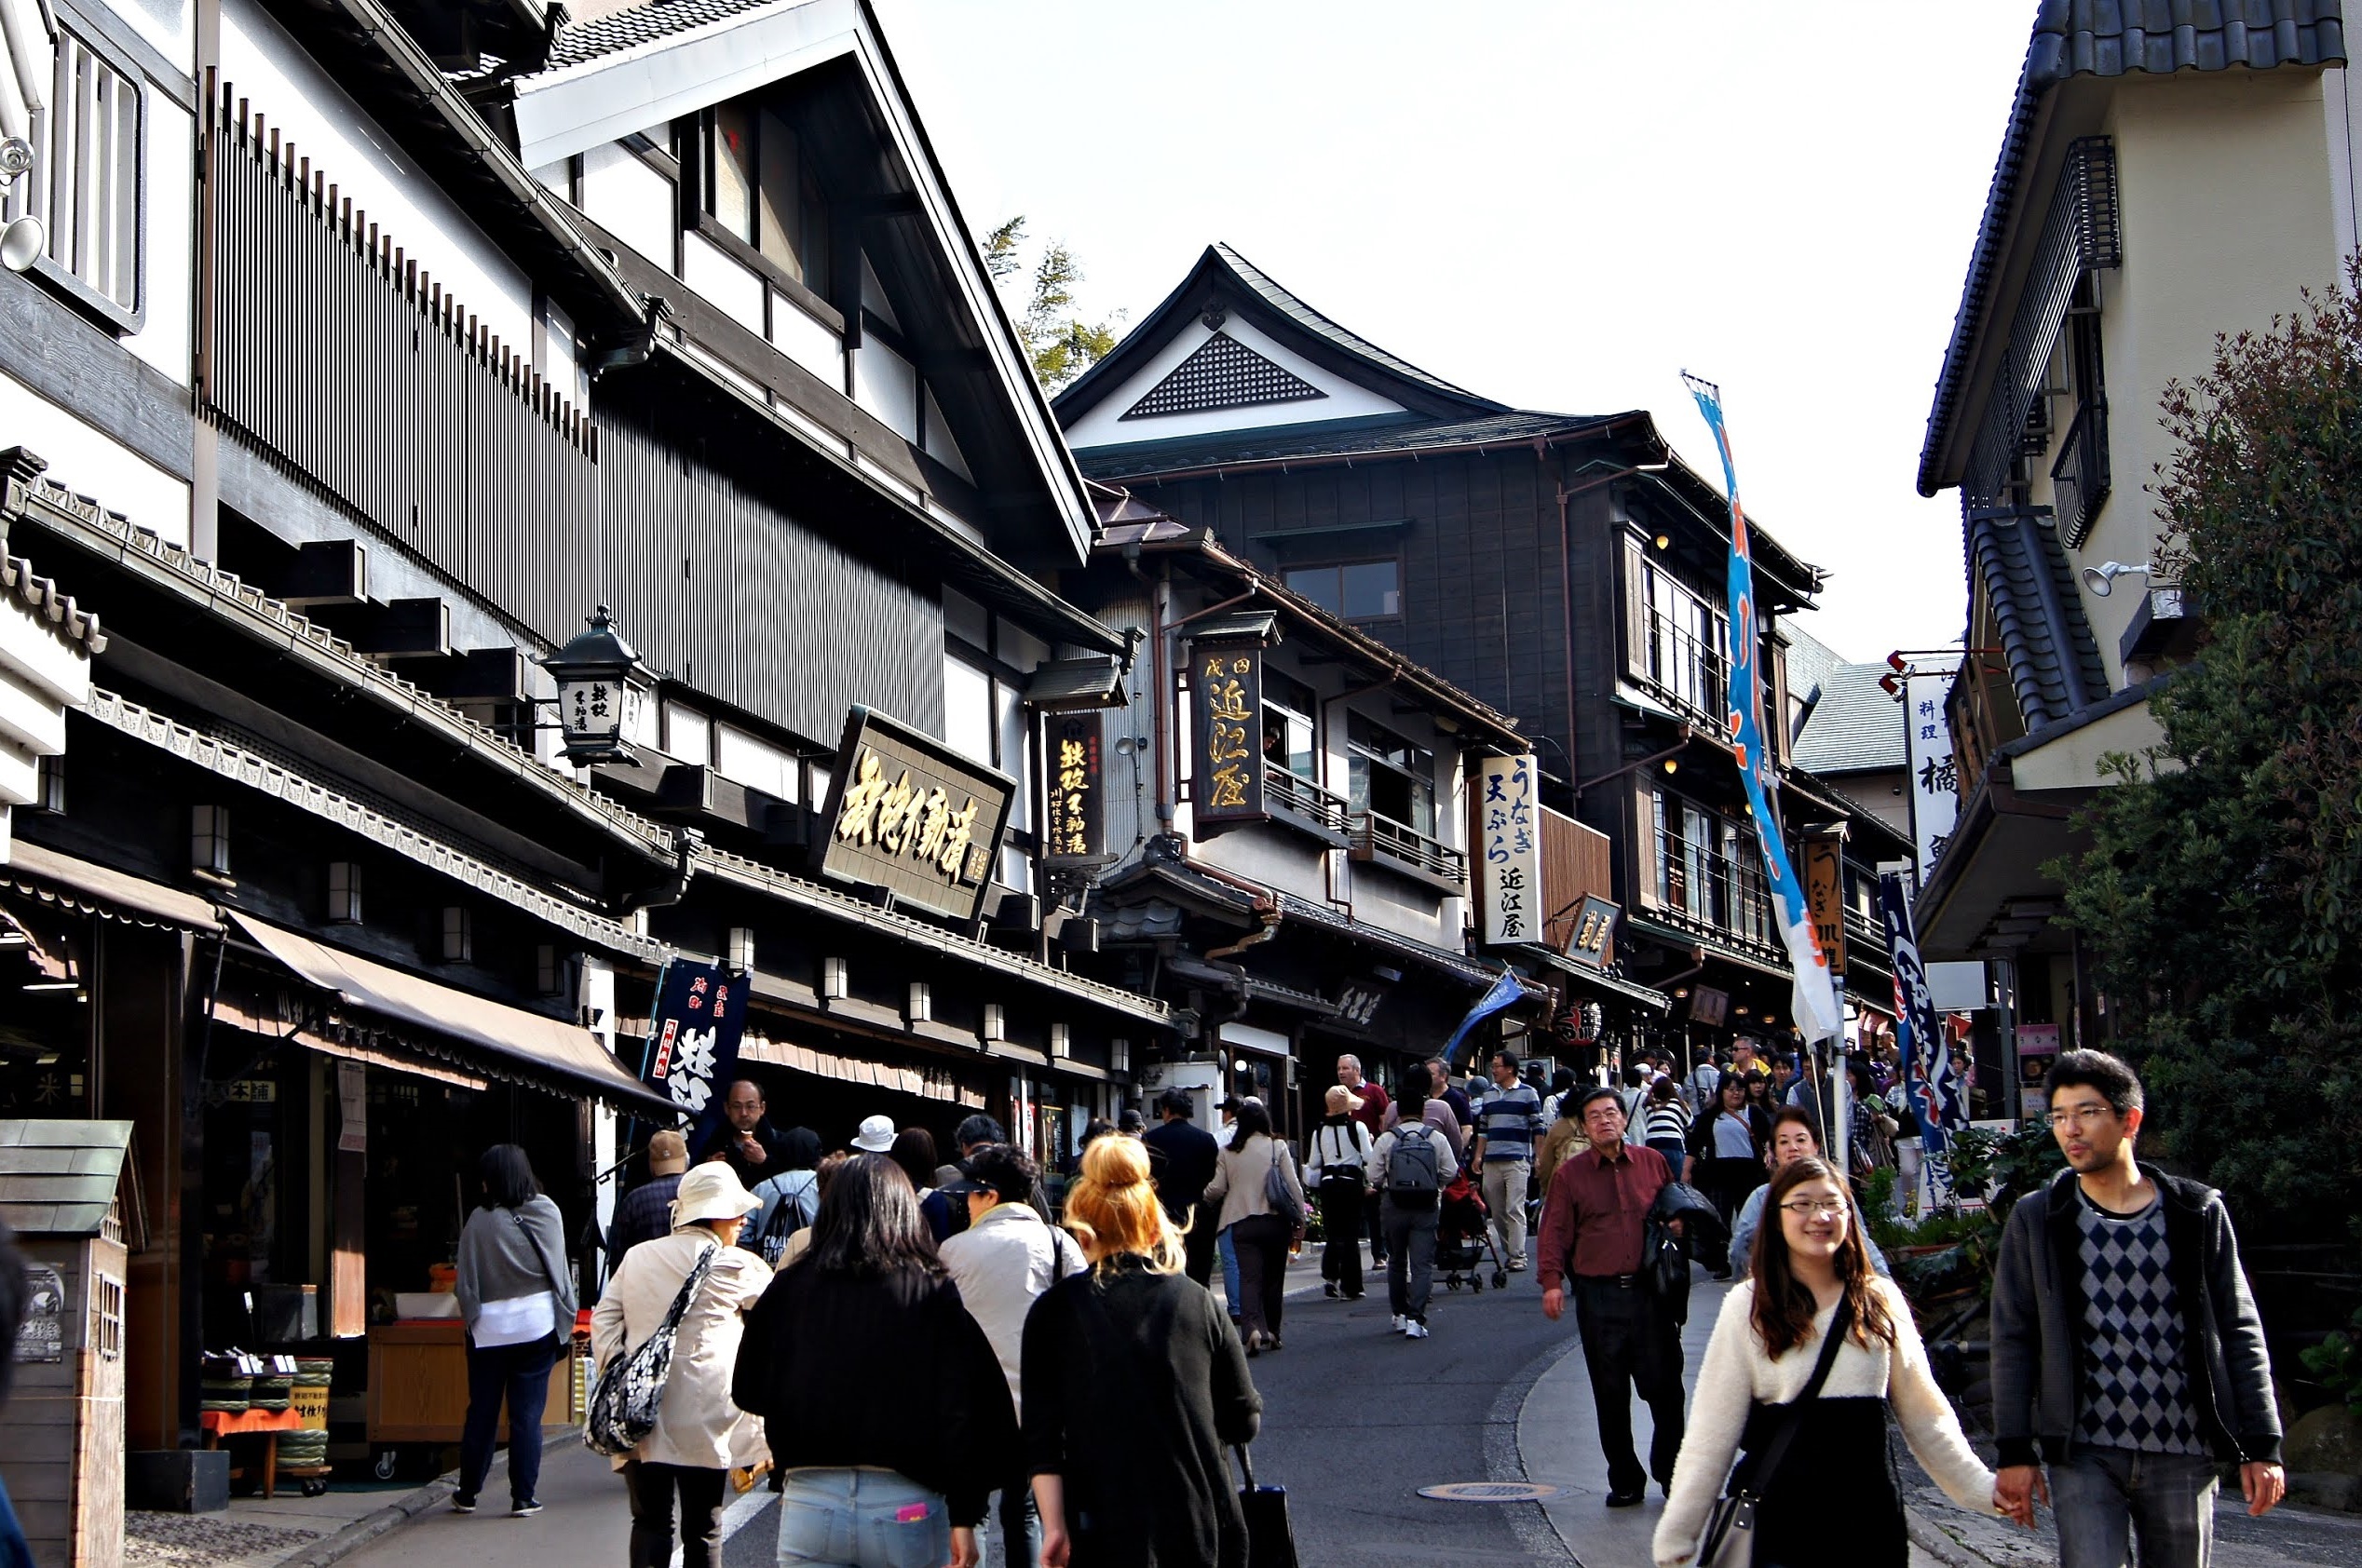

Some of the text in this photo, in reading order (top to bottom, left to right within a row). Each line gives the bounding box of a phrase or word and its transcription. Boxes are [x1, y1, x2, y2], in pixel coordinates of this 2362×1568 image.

[1210, 679, 1253, 807] 近江屋
[1919, 699, 1938, 740] 料理
[1485, 774, 1510, 865] 天ぷら
[1510, 758, 1532, 855] うなぎ
[1500, 867, 1526, 939] 近江屋
